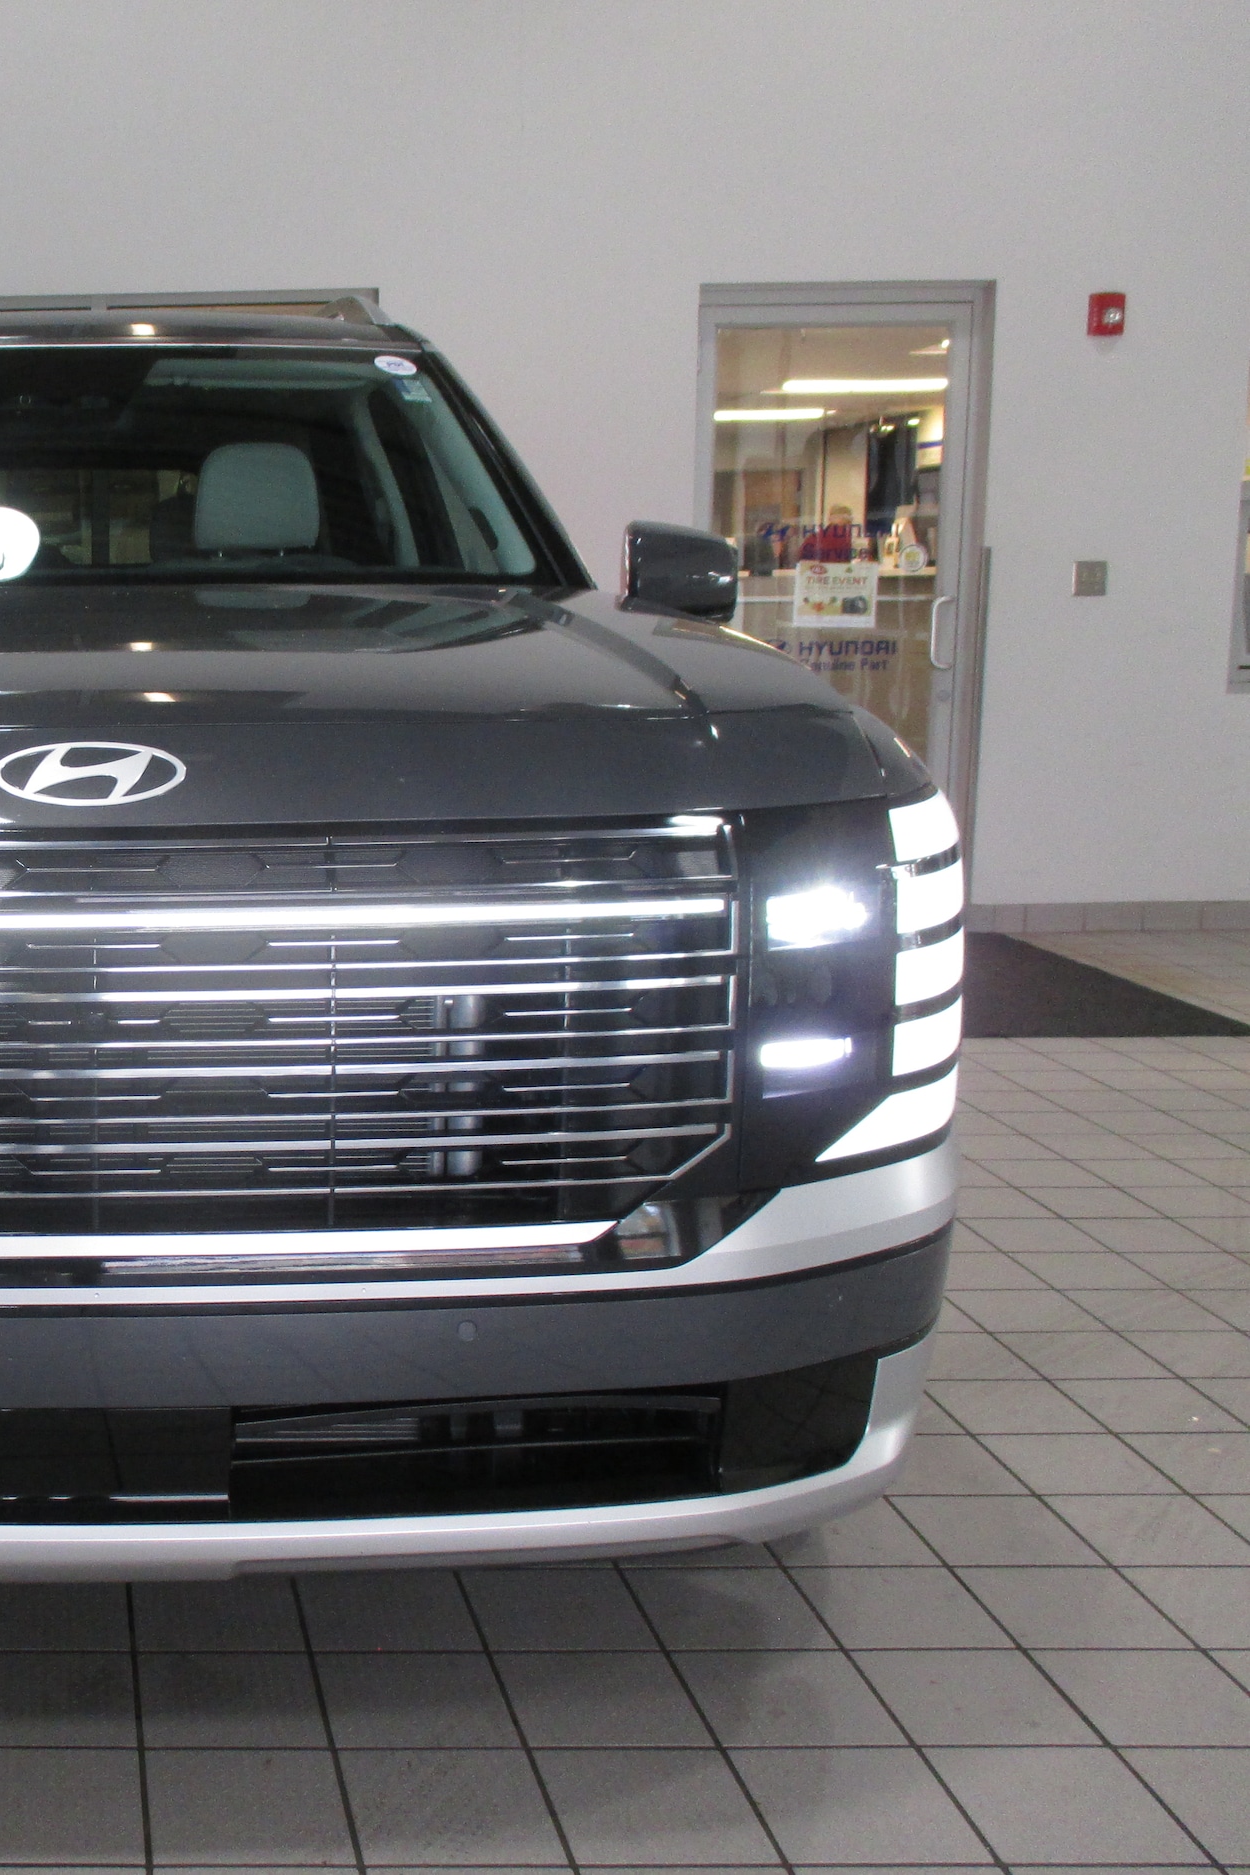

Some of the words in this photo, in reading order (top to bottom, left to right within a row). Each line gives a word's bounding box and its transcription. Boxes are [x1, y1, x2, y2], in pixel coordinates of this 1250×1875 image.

[806, 576, 829, 585] TIRE
[832, 576, 868, 585] EVENT
[799, 640, 897, 655] HYUNDAI
